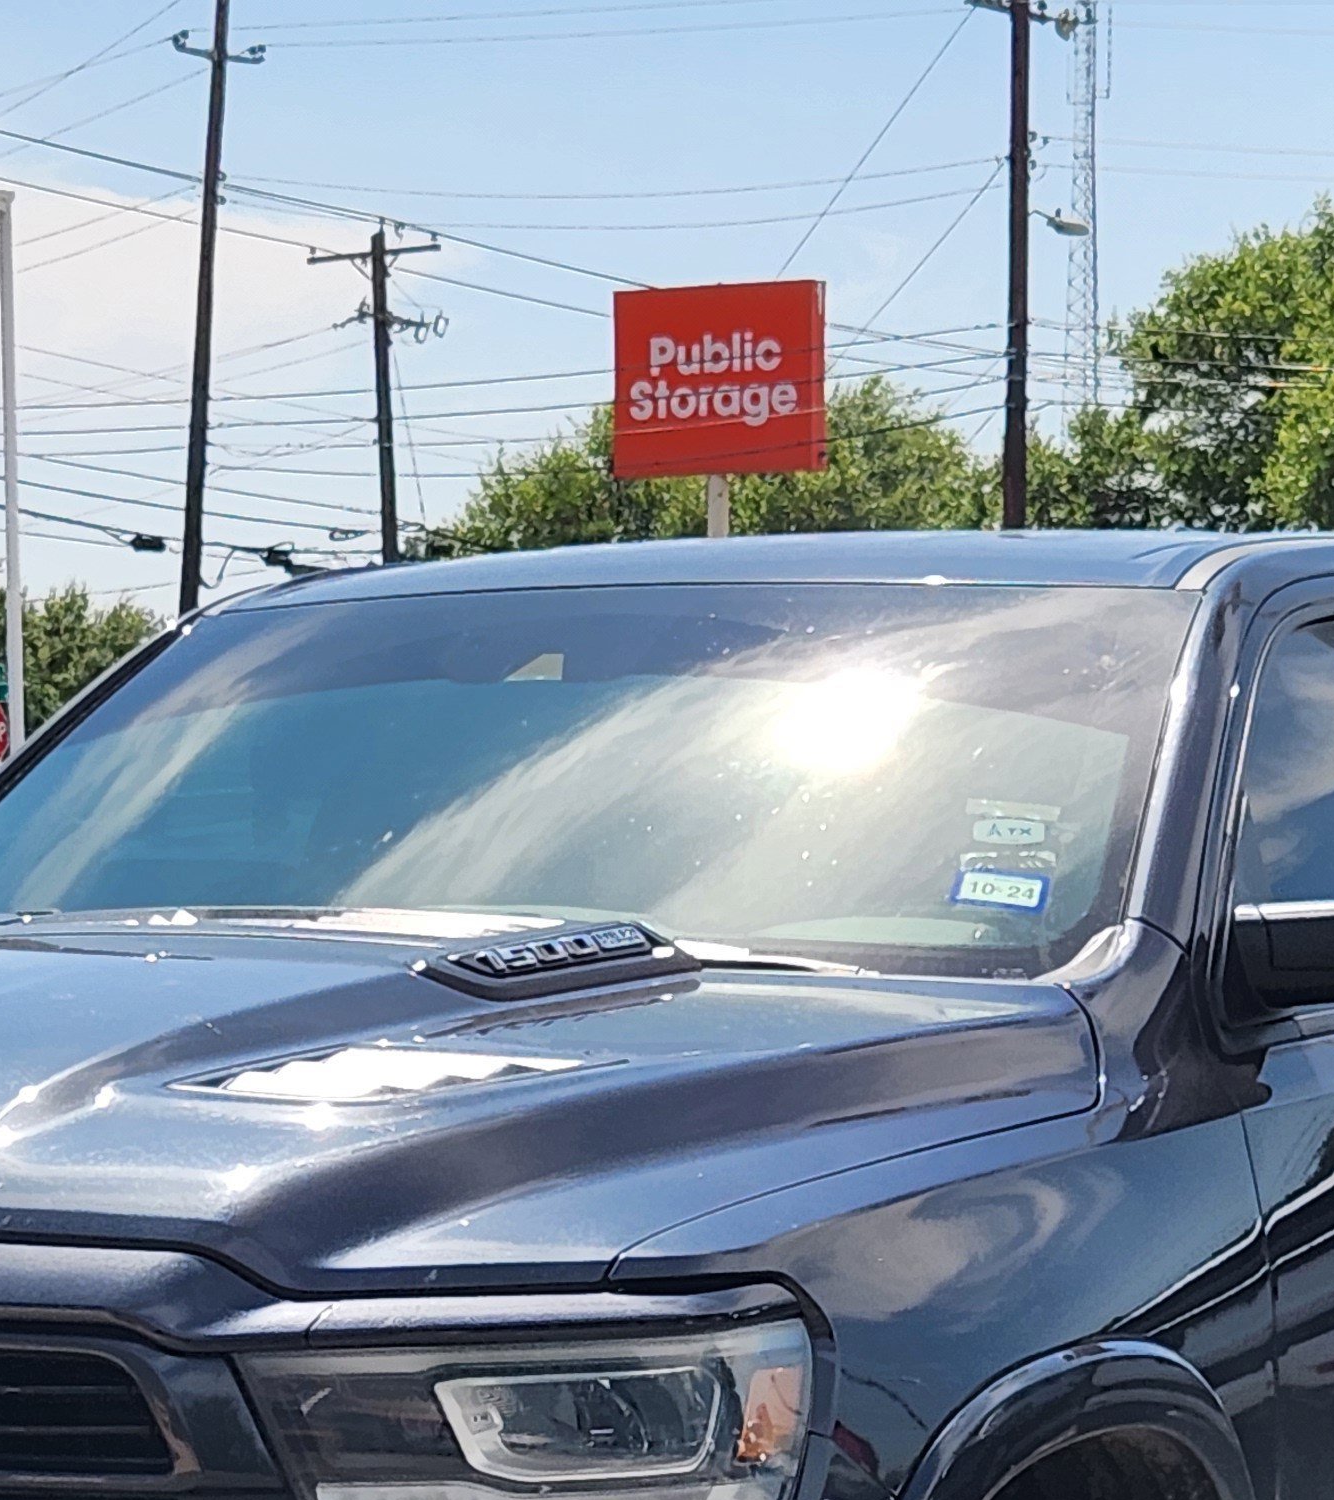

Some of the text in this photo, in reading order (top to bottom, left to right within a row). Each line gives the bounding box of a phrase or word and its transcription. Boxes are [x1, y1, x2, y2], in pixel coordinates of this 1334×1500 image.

[649, 331, 782, 377] Public
[629, 380, 798, 427] Storage
[473, 932, 600, 973] 1500
